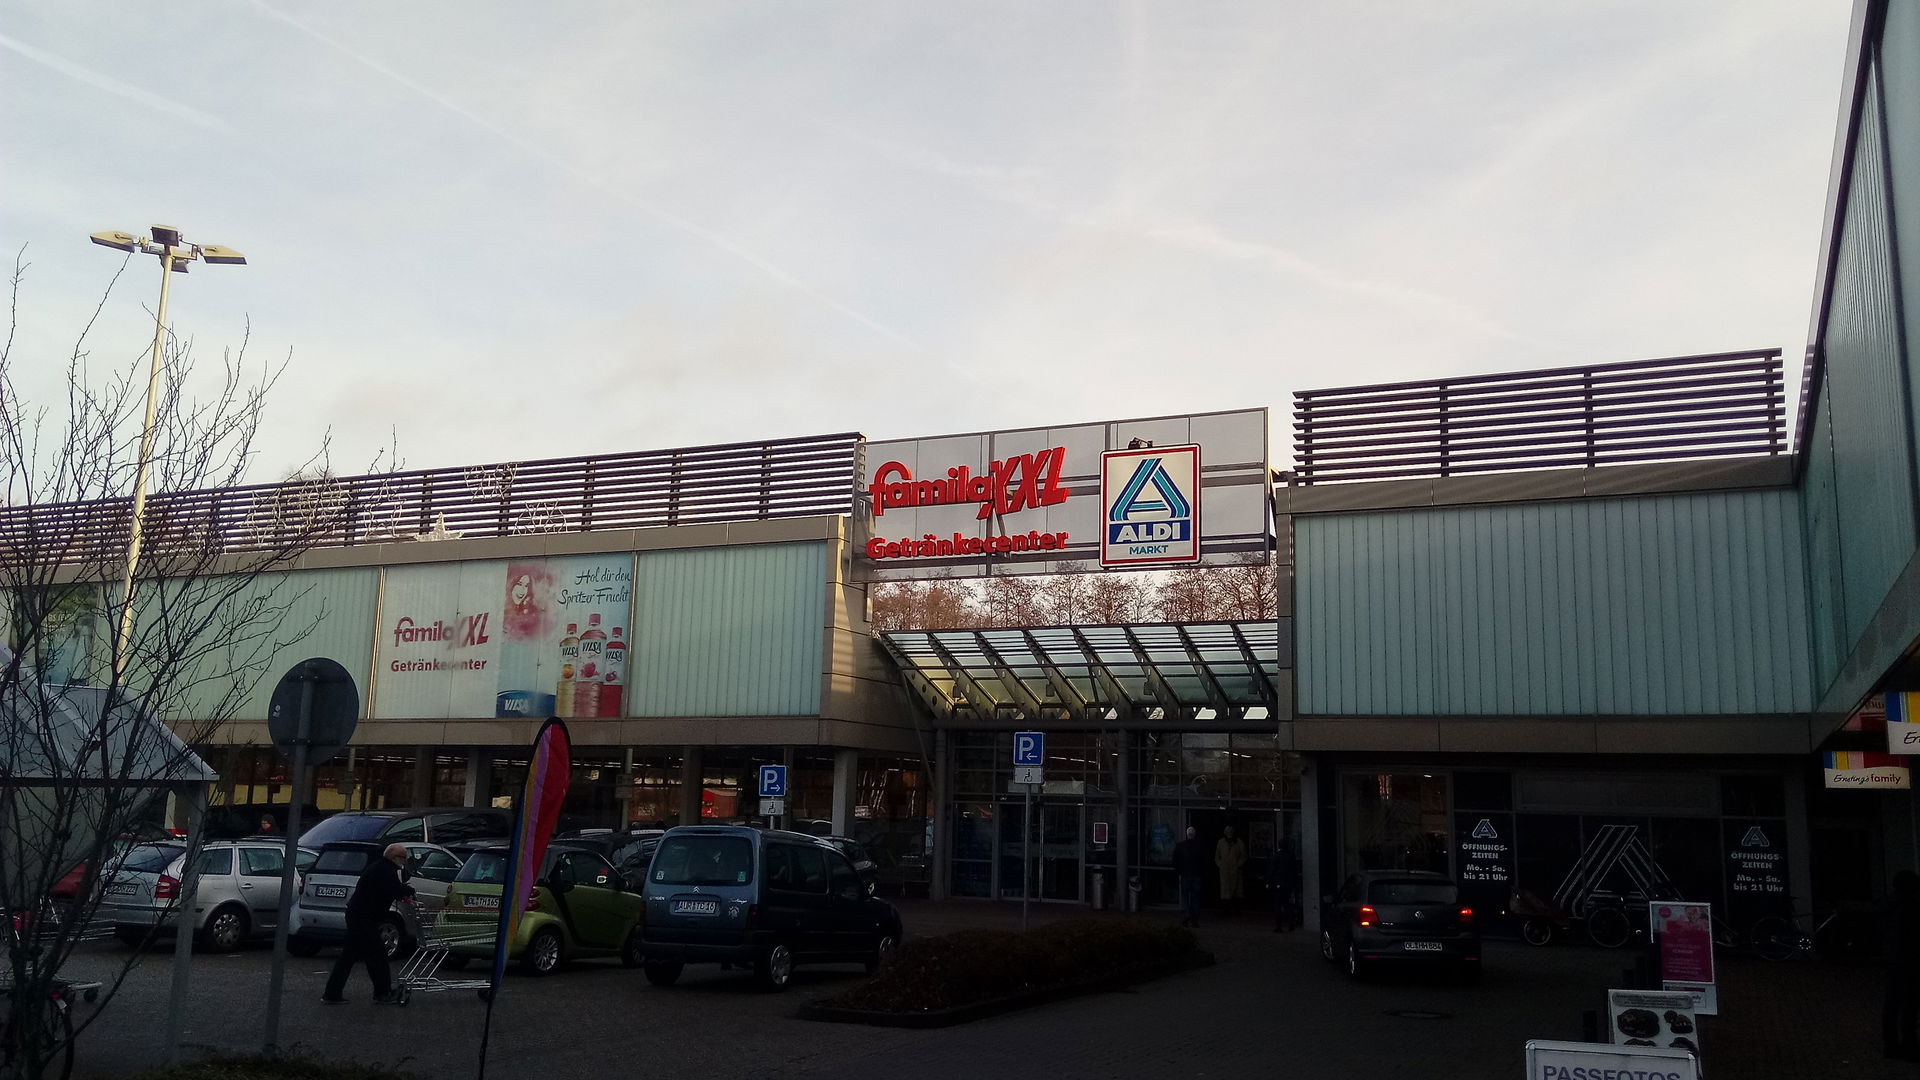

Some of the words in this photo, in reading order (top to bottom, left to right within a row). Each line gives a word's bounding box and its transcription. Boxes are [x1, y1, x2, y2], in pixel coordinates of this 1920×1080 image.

[1116, 521, 1182, 544] ALDI
[866, 529, 1070, 560] Getränkecenter
[1129, 544, 1169, 556] MARKT
[575, 566, 600, 585] Hol
[601, 567, 615, 582] dir
[557, 589, 595, 610] Spritzer
[582, 641, 602, 655] VILSA
[1018, 736, 1035, 760] P
[763, 769, 778, 792] P
[1870, 773, 1901, 785] family
[1742, 861, 1772, 869] ZEITEN
[1463, 872, 1477, 880] bis
[1492, 873, 1508, 881] Uhr
[1733, 883, 1748, 891] bis
[1766, 884, 1784, 892] Uhr
